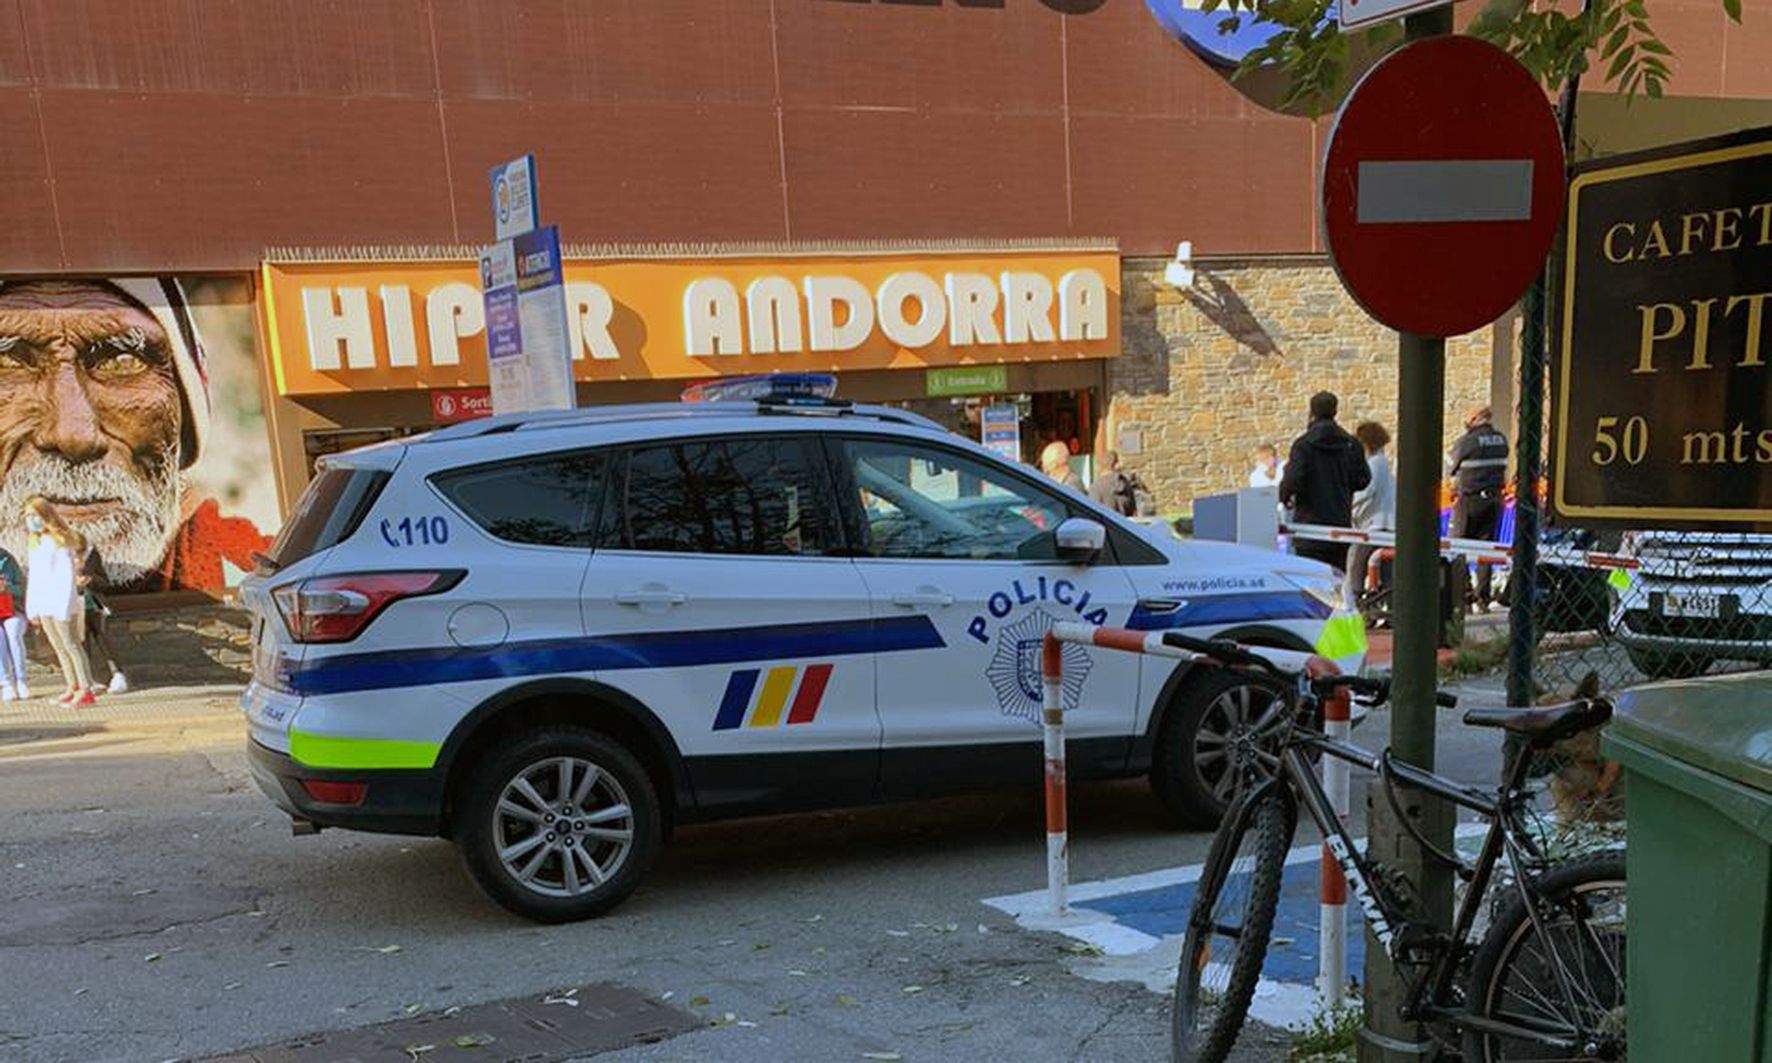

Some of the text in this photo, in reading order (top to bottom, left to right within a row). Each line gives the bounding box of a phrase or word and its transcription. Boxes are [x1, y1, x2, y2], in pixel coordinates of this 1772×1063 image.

[1603, 202, 1772, 264] CAFET
[301, 282, 620, 370] HIPR
[683, 269, 1108, 357] ANDORRA
[1631, 292, 1772, 374] PIT
[1592, 415, 1772, 465] 50 mts
[398, 516, 449, 546] 110
[966, 576, 1109, 644] POLICIA
